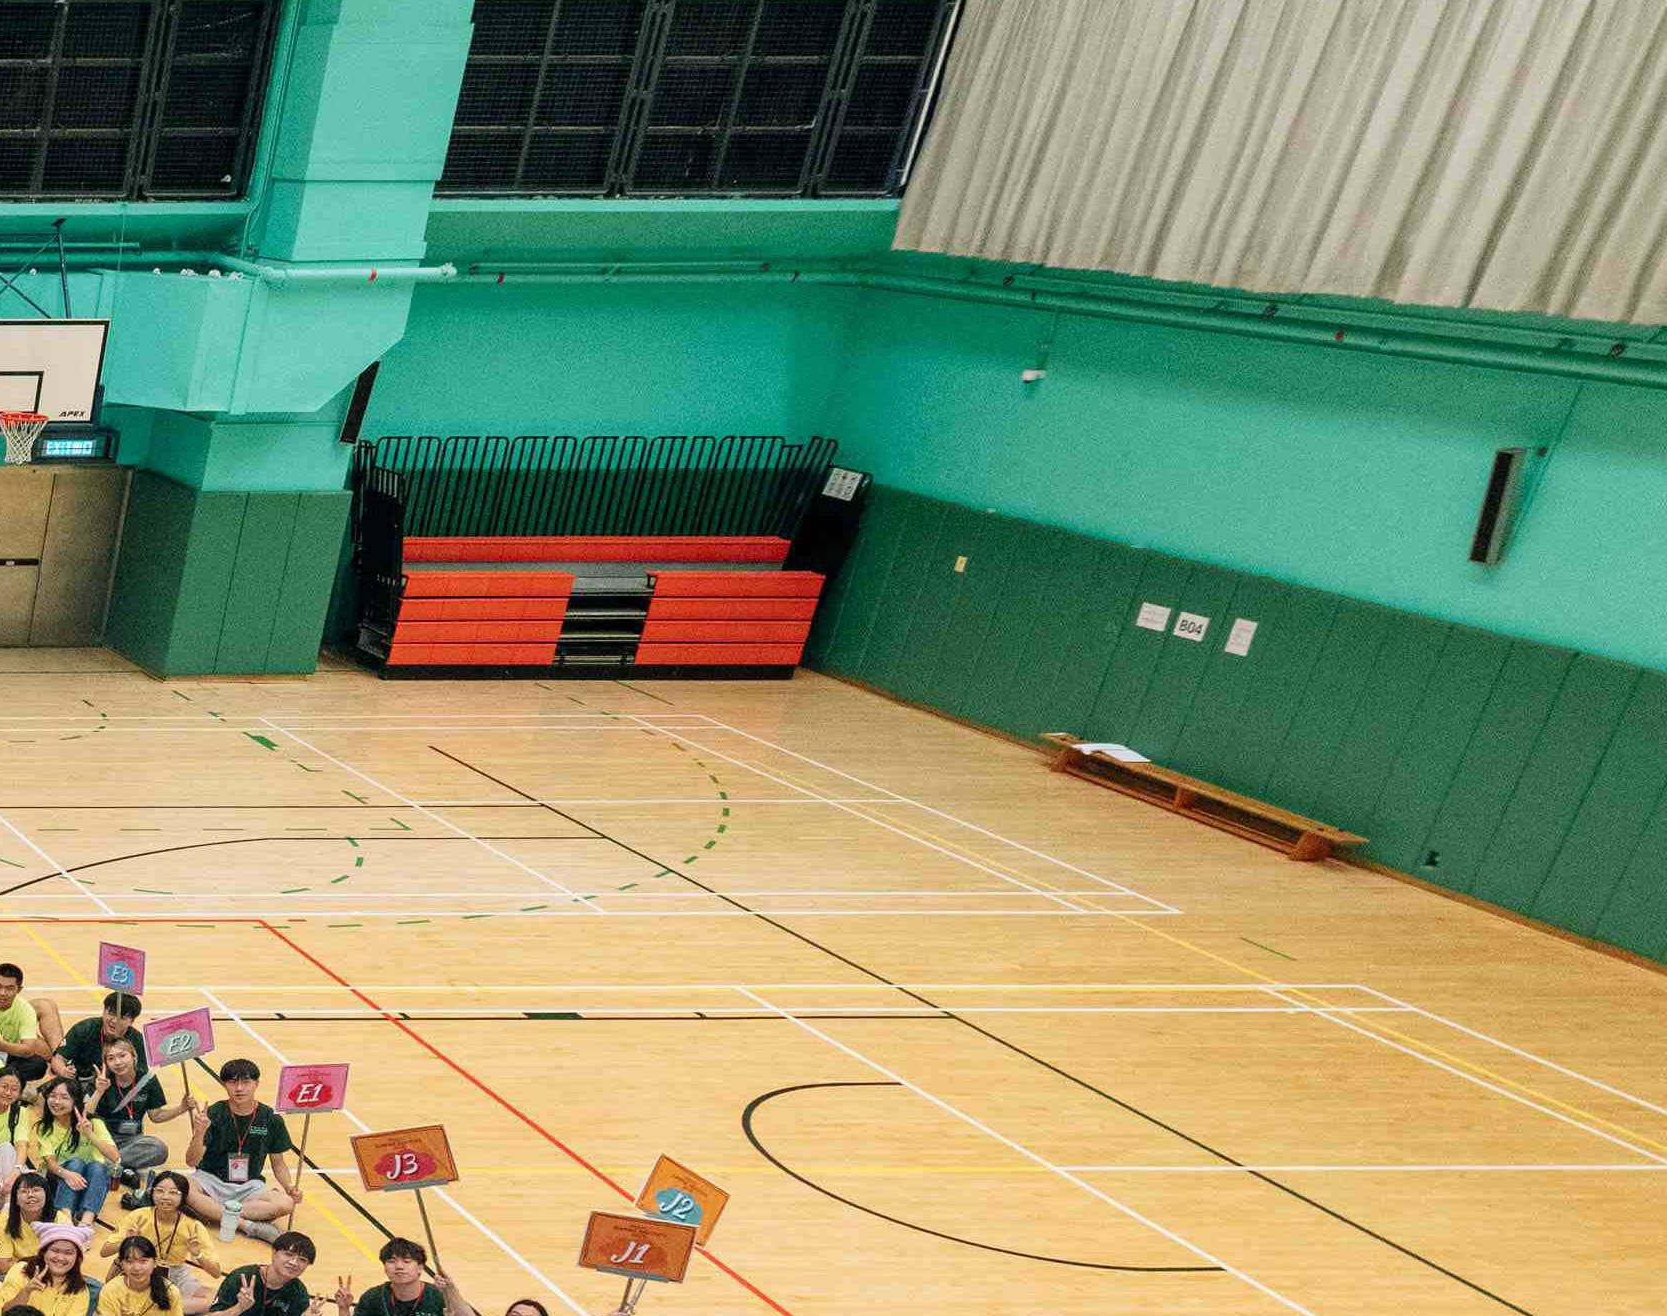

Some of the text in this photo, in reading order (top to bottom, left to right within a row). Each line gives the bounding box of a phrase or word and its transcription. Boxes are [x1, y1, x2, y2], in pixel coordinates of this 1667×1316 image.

[58, 410, 86, 418] APEX
[1178, 619, 1204, 635] B04
[111, 965, 130, 984] E3
[166, 1034, 193, 1054] E2
[295, 1083, 324, 1103] E1
[386, 1152, 419, 1180] J3
[659, 1193, 695, 1220] J2
[610, 1241, 652, 1265] J1
